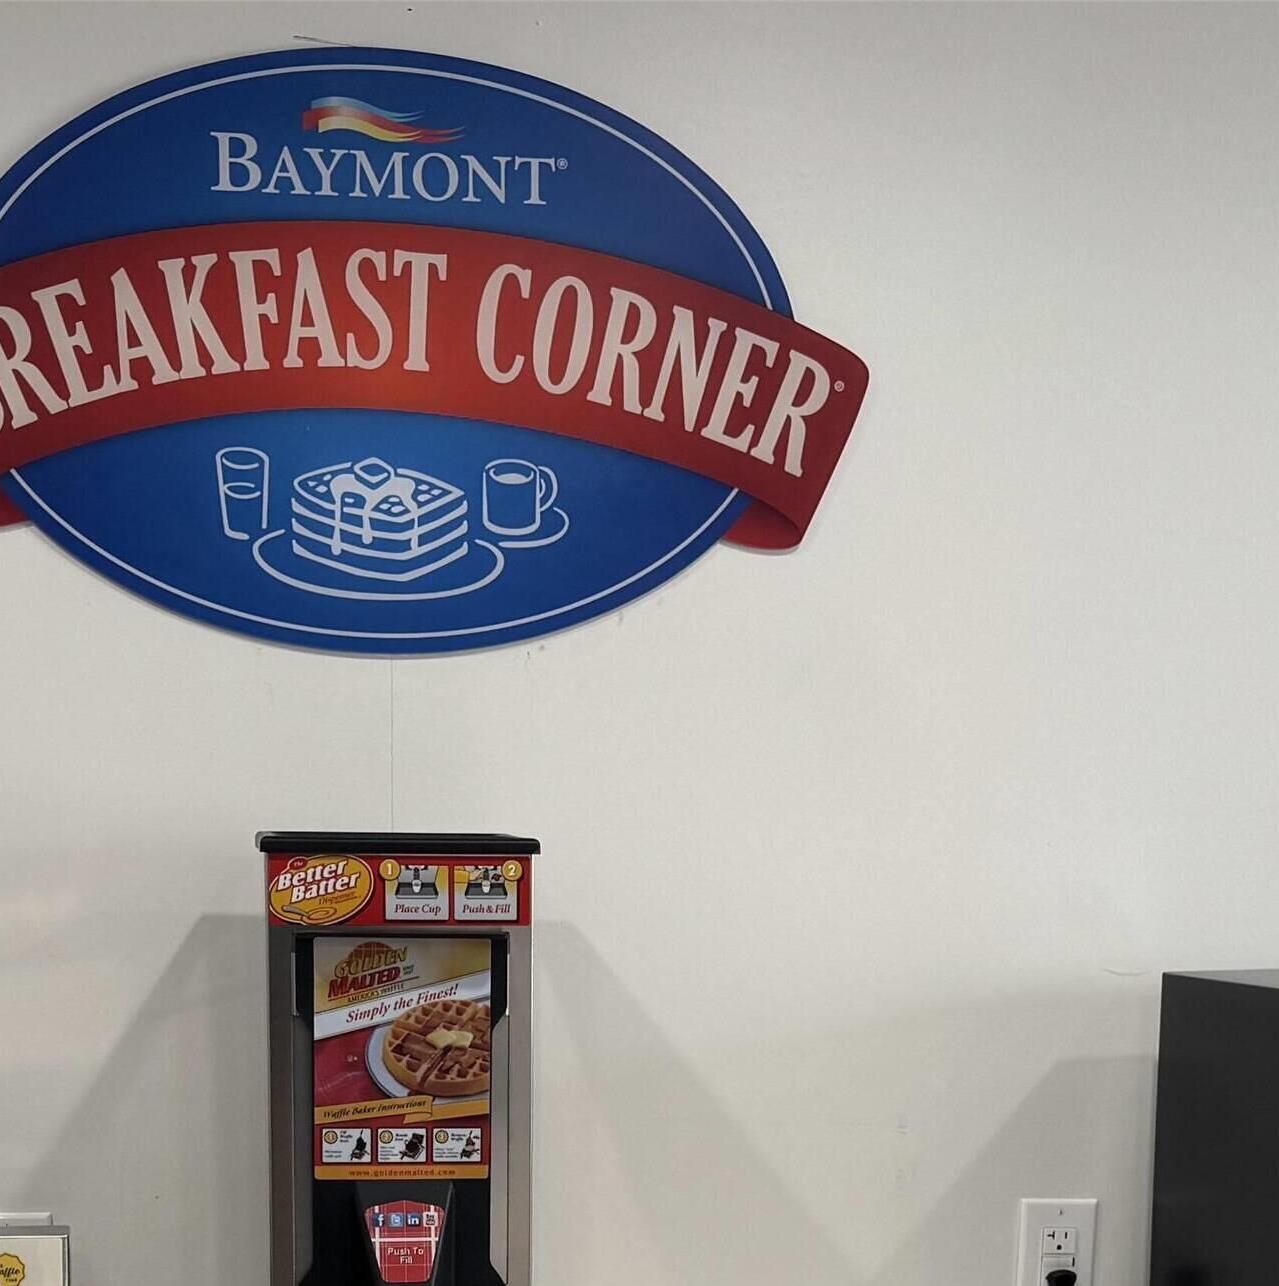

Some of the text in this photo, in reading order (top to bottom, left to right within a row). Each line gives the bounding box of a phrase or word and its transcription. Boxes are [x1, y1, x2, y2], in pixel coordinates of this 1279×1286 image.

[386, 863, 392, 875] 1
[507, 864, 516, 876] 2
[277, 860, 348, 891] Better
[290, 872, 361, 903] Batter
[394, 904, 441, 916] Place Cup
[462, 904, 510, 914] Push & Fill
[334, 947, 408, 979] GOLDEN
[327, 966, 401, 999] MALTED
[346, 983, 459, 1023] Simply the Finest!
[323, 1099, 427, 1119] Waffle Baker Instructions
[349, 1168, 456, 1178] www.goldenmalted.com
[387, 1247, 424, 1256] Push To
[400, 1256, 413, 1264] Fill
